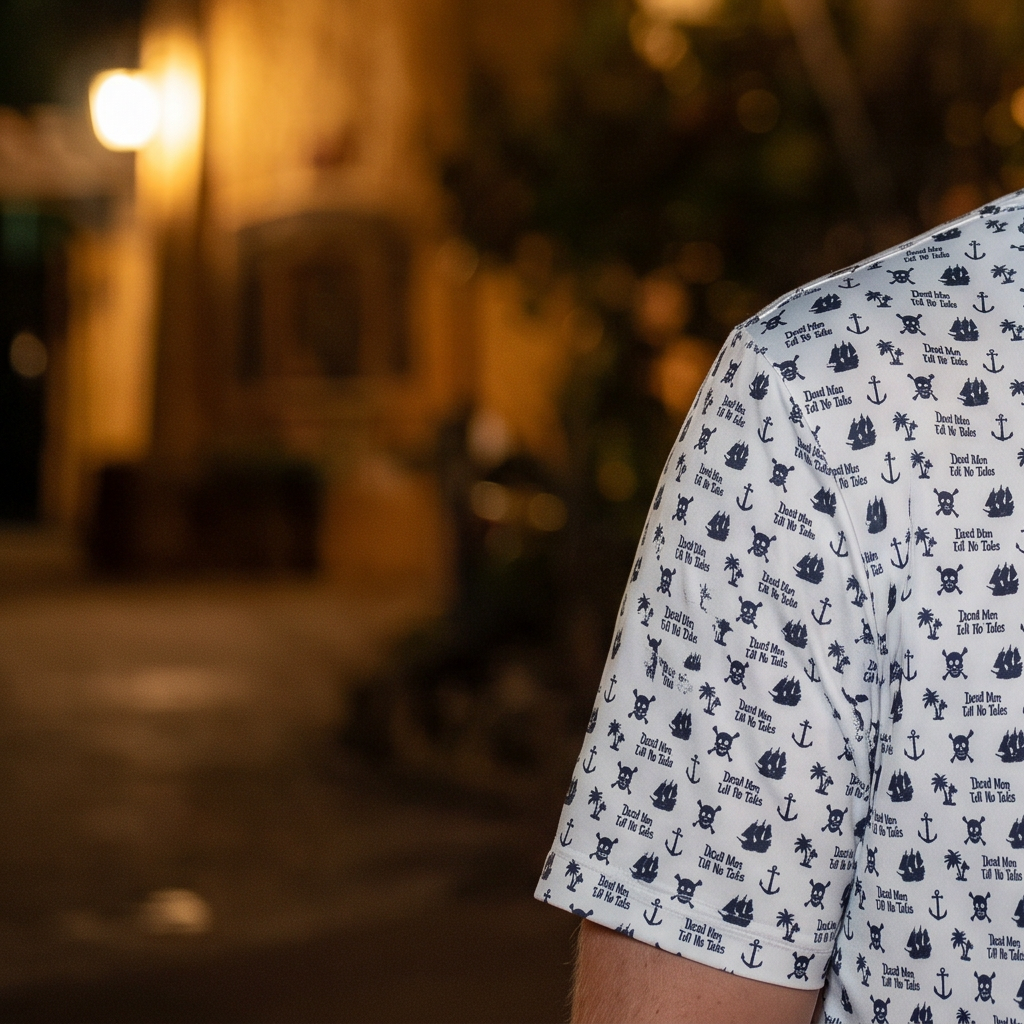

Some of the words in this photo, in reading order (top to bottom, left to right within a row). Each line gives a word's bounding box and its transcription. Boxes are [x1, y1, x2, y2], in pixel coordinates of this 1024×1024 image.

[963, 465, 975, 478] No
[976, 704, 987, 717] No
[746, 714, 757, 729] No
[711, 861, 725, 876] No
